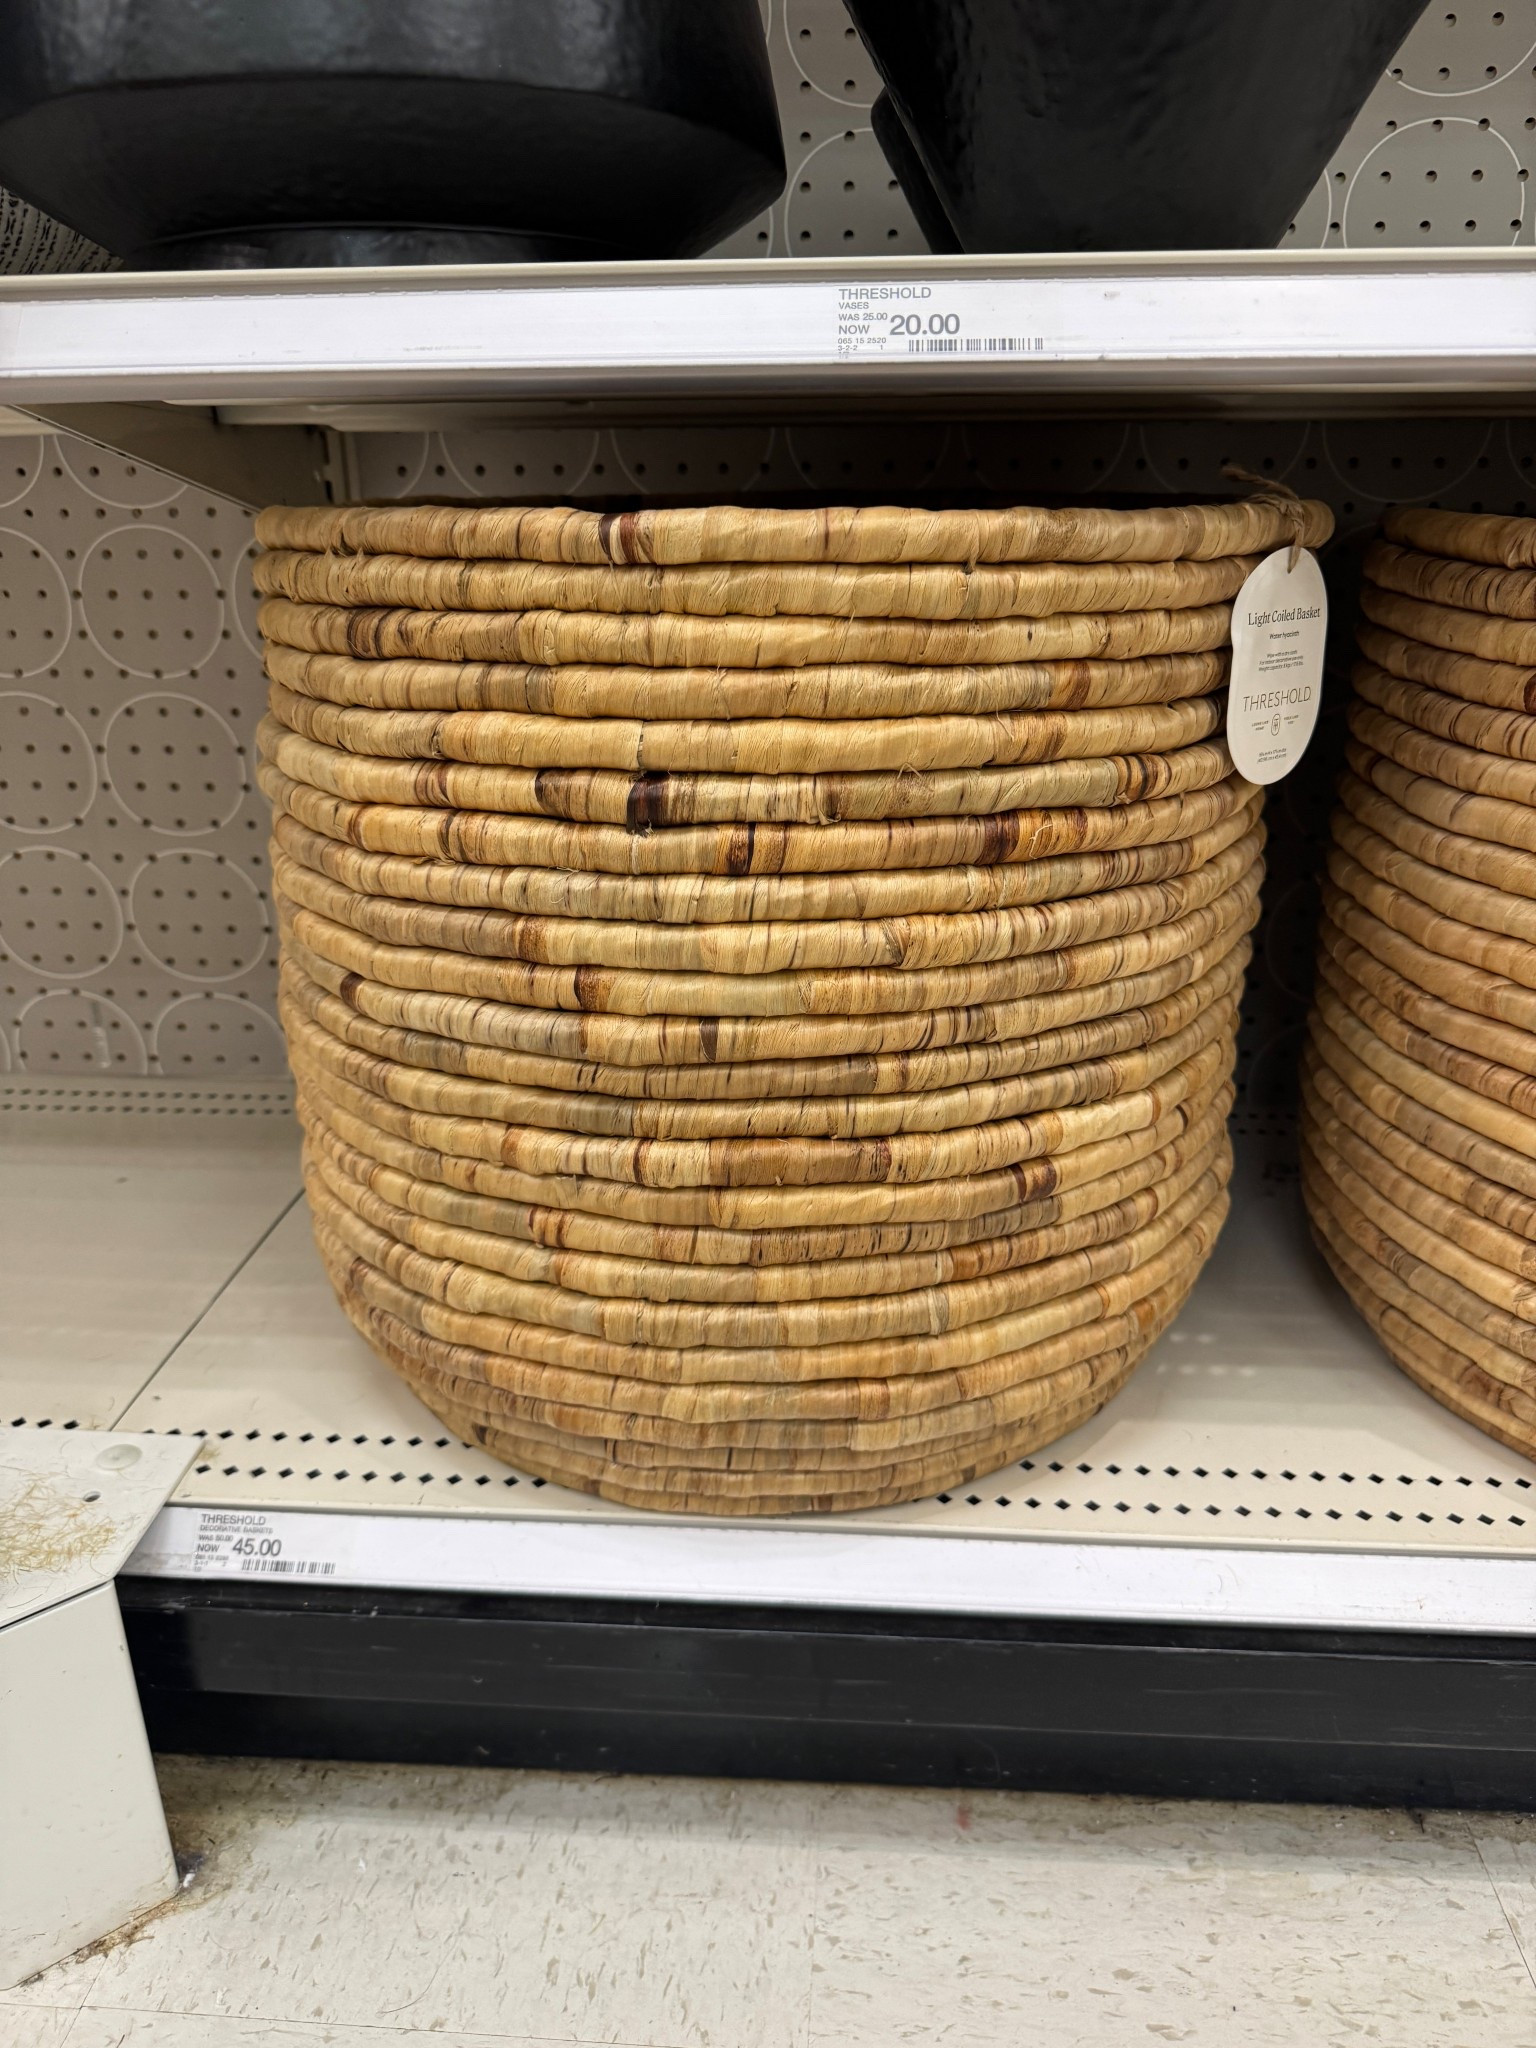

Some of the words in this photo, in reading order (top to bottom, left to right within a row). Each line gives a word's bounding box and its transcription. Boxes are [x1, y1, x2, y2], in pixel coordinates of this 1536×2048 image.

[838, 286, 932, 300] THRESHOLD
[838, 301, 869, 310] VASES
[838, 313, 860, 321] WAS
[862, 312, 888, 321] 25.00
[838, 324, 870, 335] NOW
[889, 313, 961, 335] 20.00
[837, 337, 853, 345] 065
[1248, 611, 1271, 627] Light
[1272, 608, 1295, 623] Coiled
[1297, 606, 1320, 620] Basket
[1243, 686, 1312, 713] THRESHOLD
[201, 1513, 267, 1526] THRESHOLD
[199, 1524, 241, 1533] DECORATIVE
[197, 1543, 220, 1553] NOW
[232, 1536, 283, 1557] 45.00
